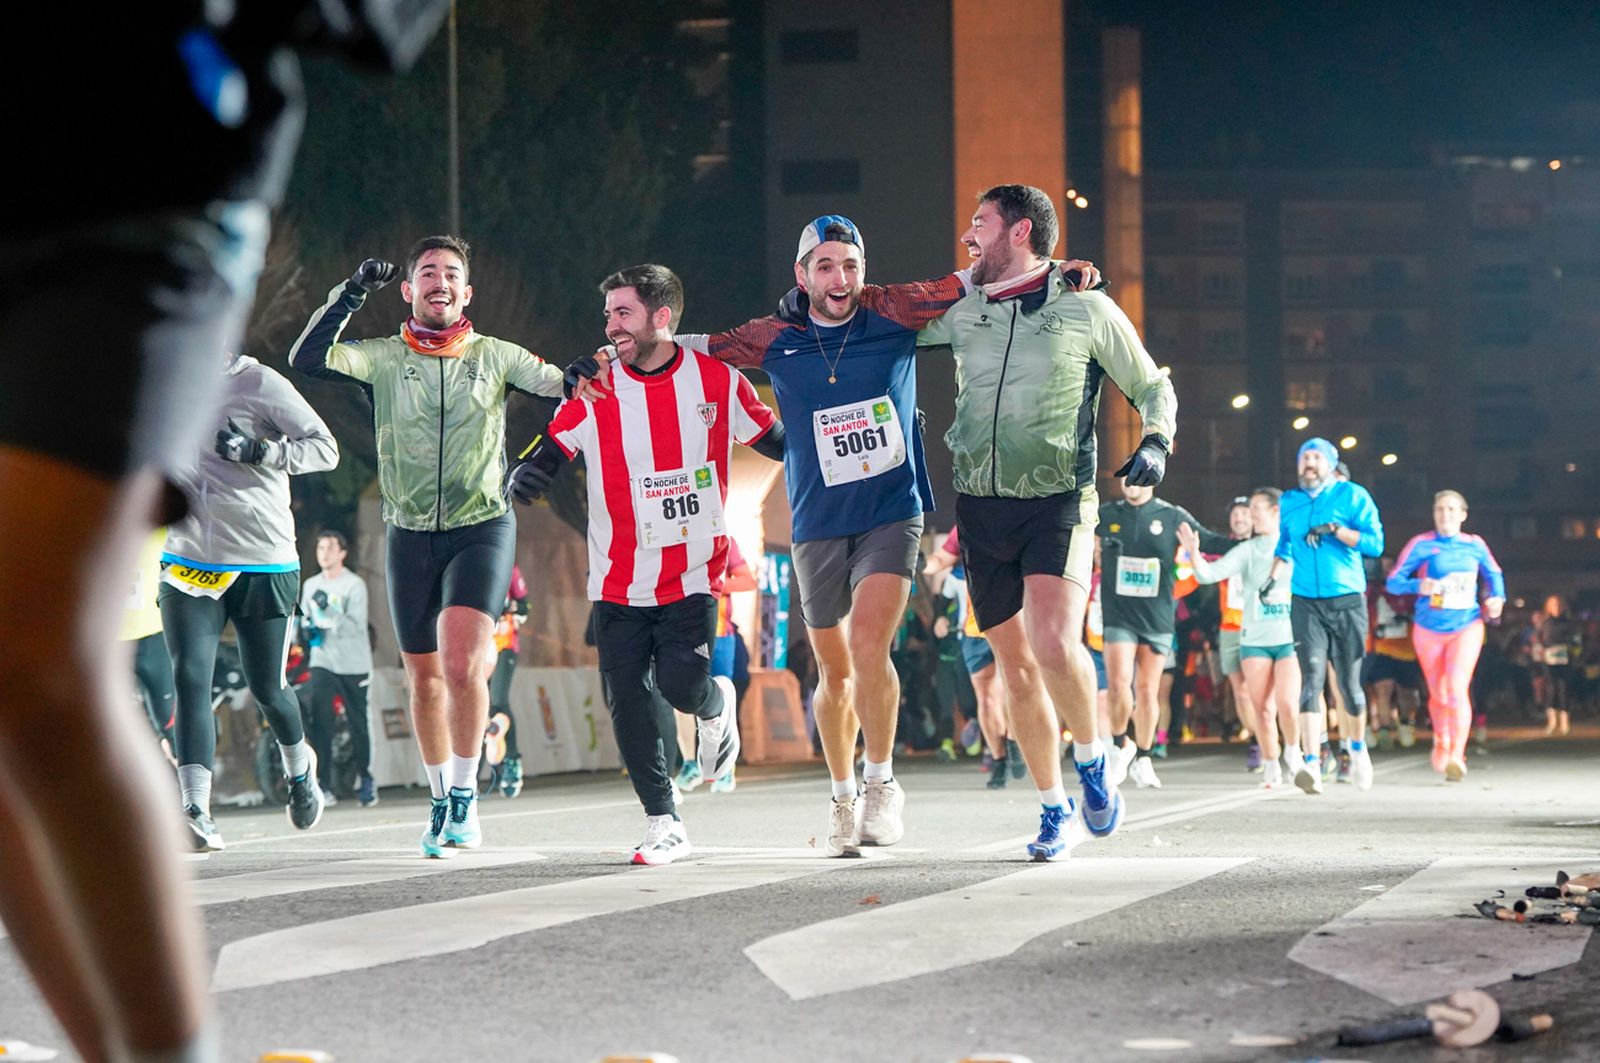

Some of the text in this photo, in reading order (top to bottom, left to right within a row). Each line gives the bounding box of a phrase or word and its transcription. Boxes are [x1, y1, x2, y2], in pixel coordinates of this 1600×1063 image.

[830, 414, 854, 424] NOCHE
[856, 410, 866, 419] DE
[823, 426, 839, 436] SAN
[833, 425, 888, 457] 5061
[654, 478, 678, 488] NOCHE
[679, 475, 689, 484] DE
[645, 489, 662, 499] SAN
[662, 492, 700, 520] 816
